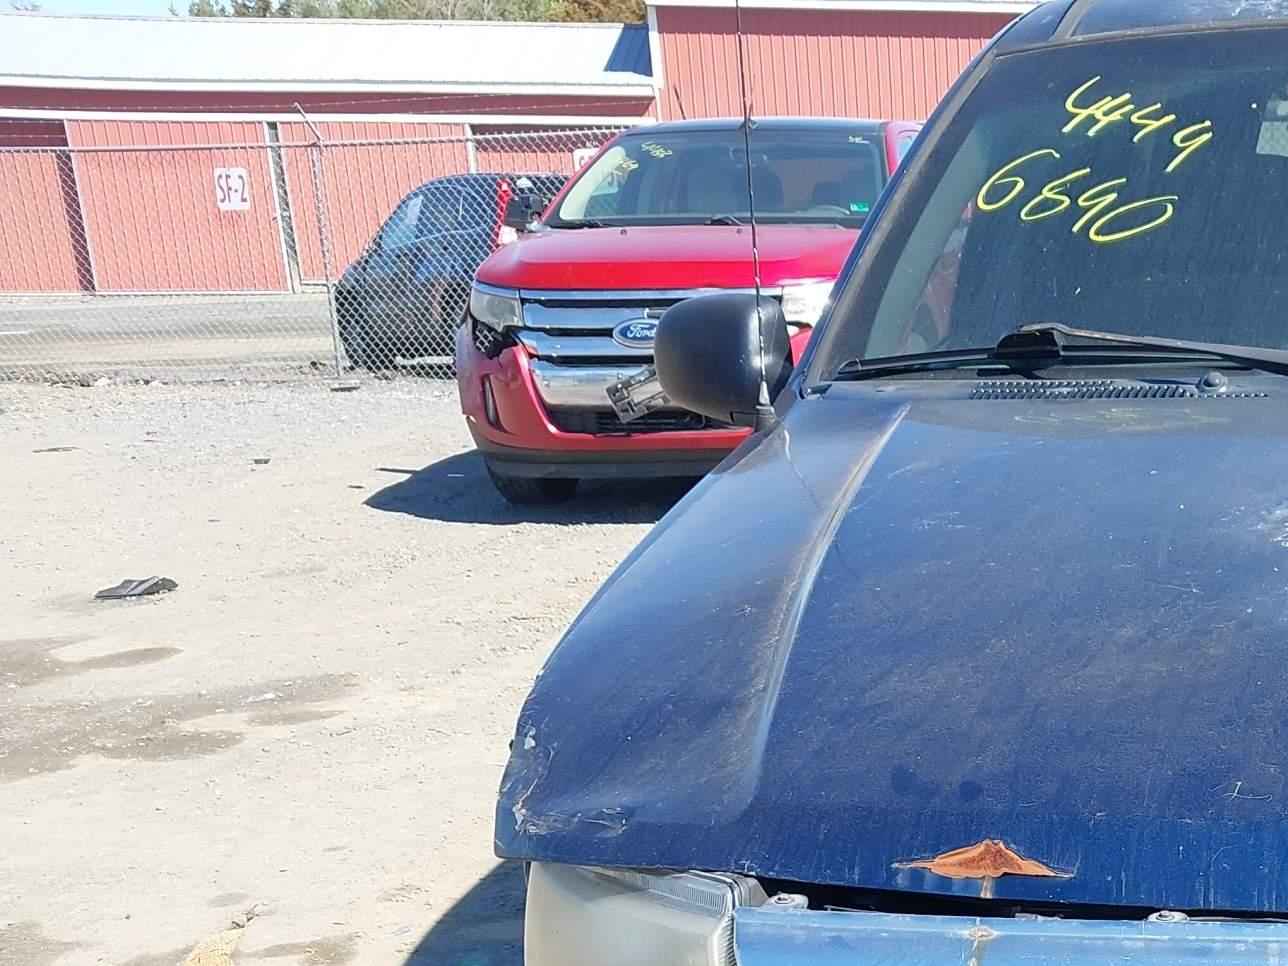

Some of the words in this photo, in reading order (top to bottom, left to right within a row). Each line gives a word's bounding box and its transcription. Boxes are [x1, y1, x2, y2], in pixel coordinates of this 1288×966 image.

[1061, 75, 1212, 172] 4449
[217, 173, 248, 203] SF-2
[976, 148, 1179, 242] 6890
[627, 323, 657, 338] Ford
